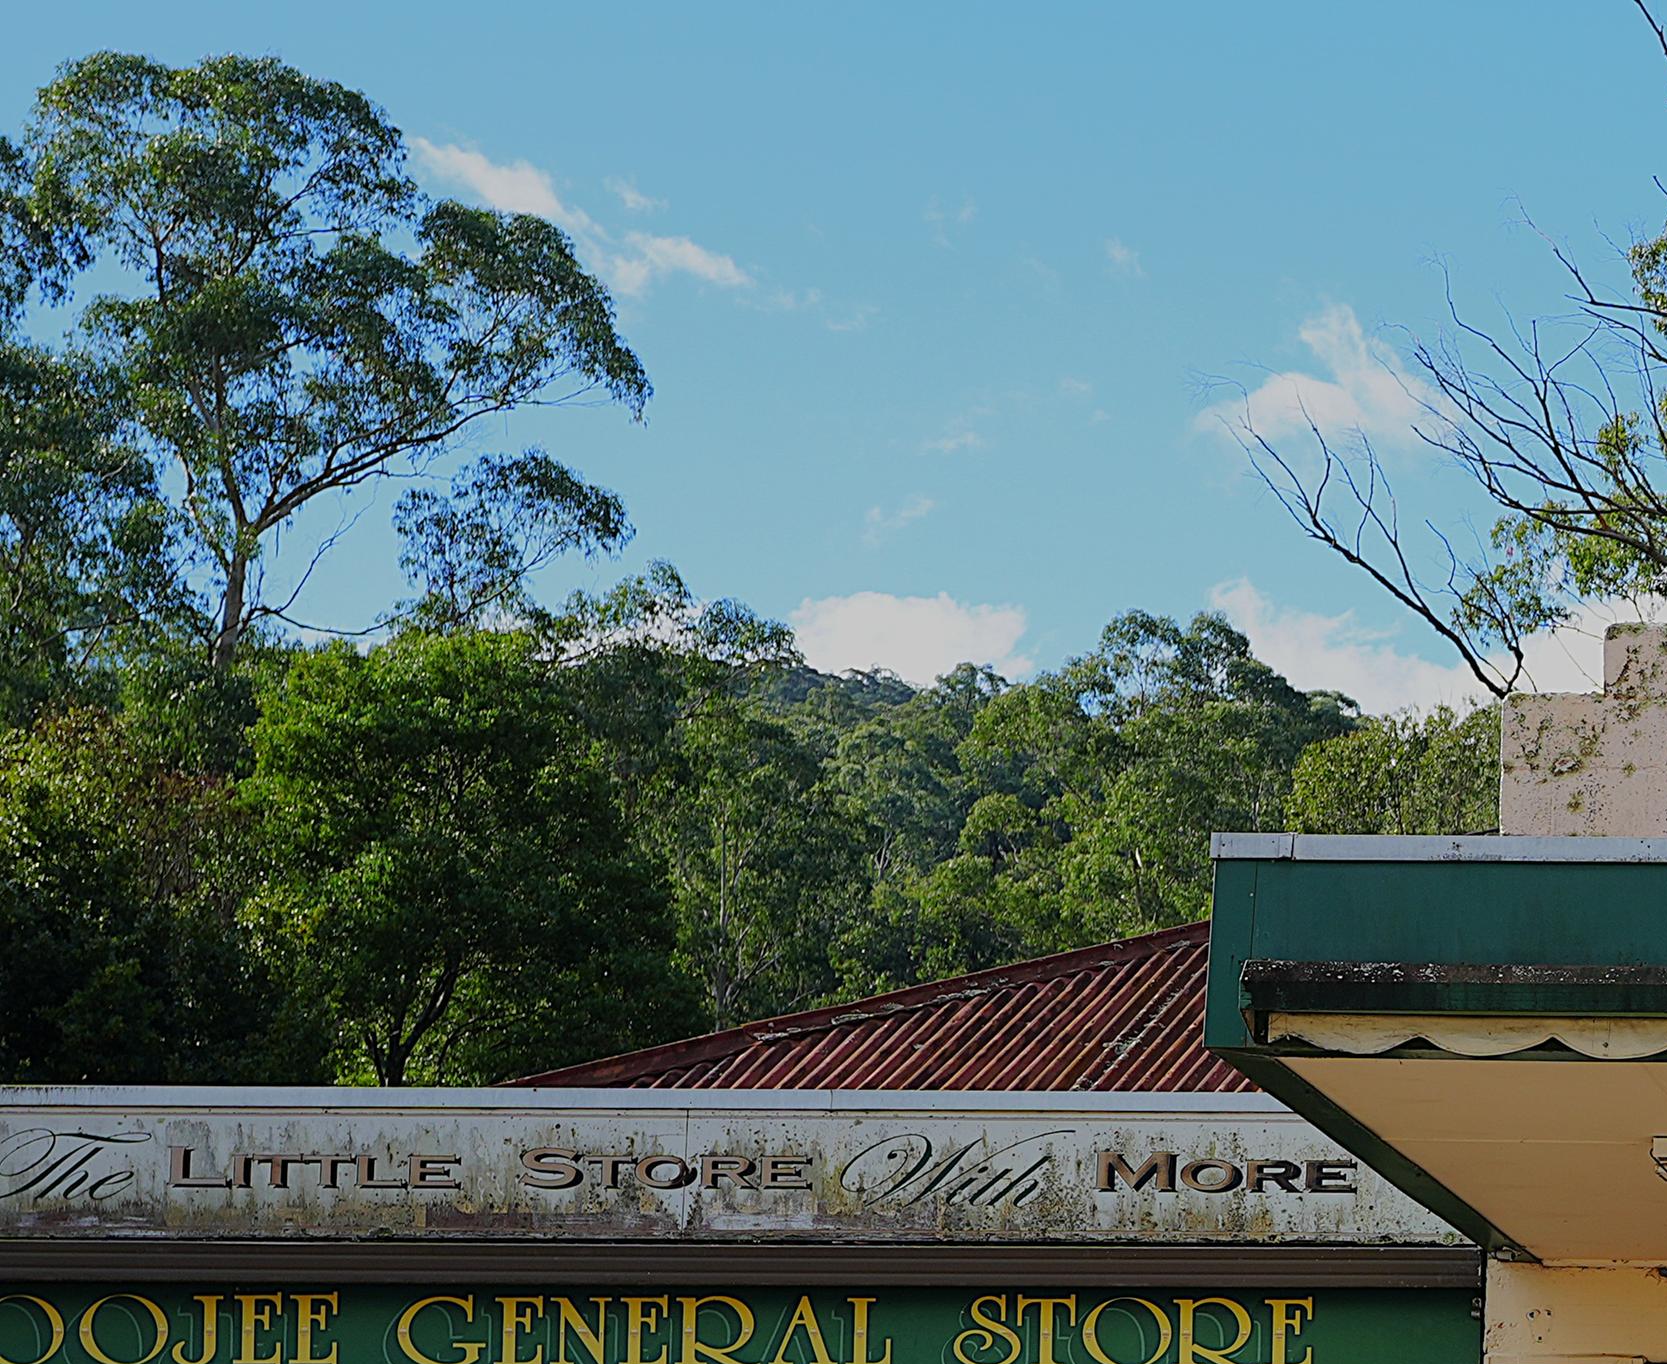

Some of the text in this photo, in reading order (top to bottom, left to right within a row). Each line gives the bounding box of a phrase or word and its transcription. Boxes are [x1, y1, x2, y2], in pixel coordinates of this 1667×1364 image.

[0, 1129, 1358, 1206] The LITTLE STORE With MORE
